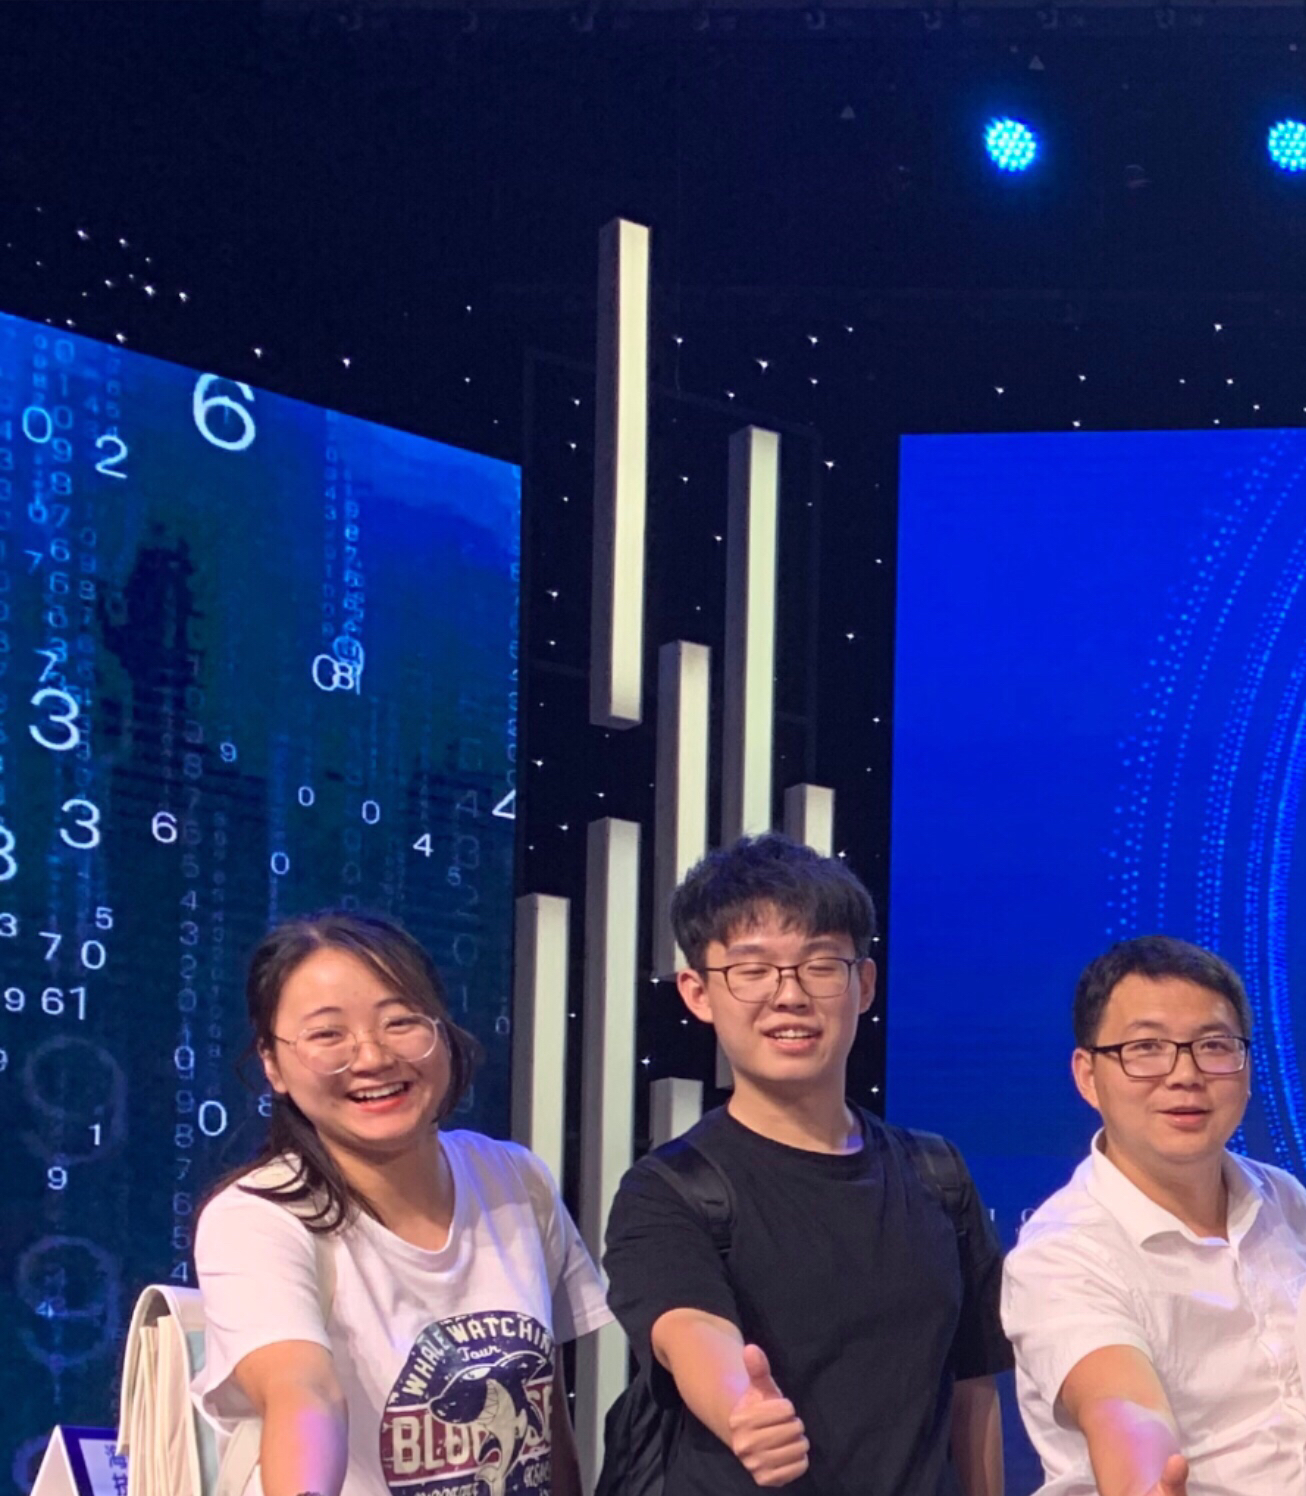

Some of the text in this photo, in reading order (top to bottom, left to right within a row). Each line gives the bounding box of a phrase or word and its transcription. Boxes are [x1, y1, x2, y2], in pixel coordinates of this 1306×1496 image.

[193, 373, 256, 451] 6
[95, 434, 128, 479] 2
[29, 687, 80, 751] 3
[60, 798, 101, 849] 3
[151, 812, 177, 843] 6
[413, 834, 433, 857] 4
[95, 906, 114, 930] 5
[38, 931, 62, 960] 7
[80, 940, 106, 970] 0
[199, 1100, 227, 1137] 0
[47, 1166, 68, 1190] 9
[402, 1317, 555, 1396] WHALE WATCHIN
[456, 1344, 503, 1362] Tour
